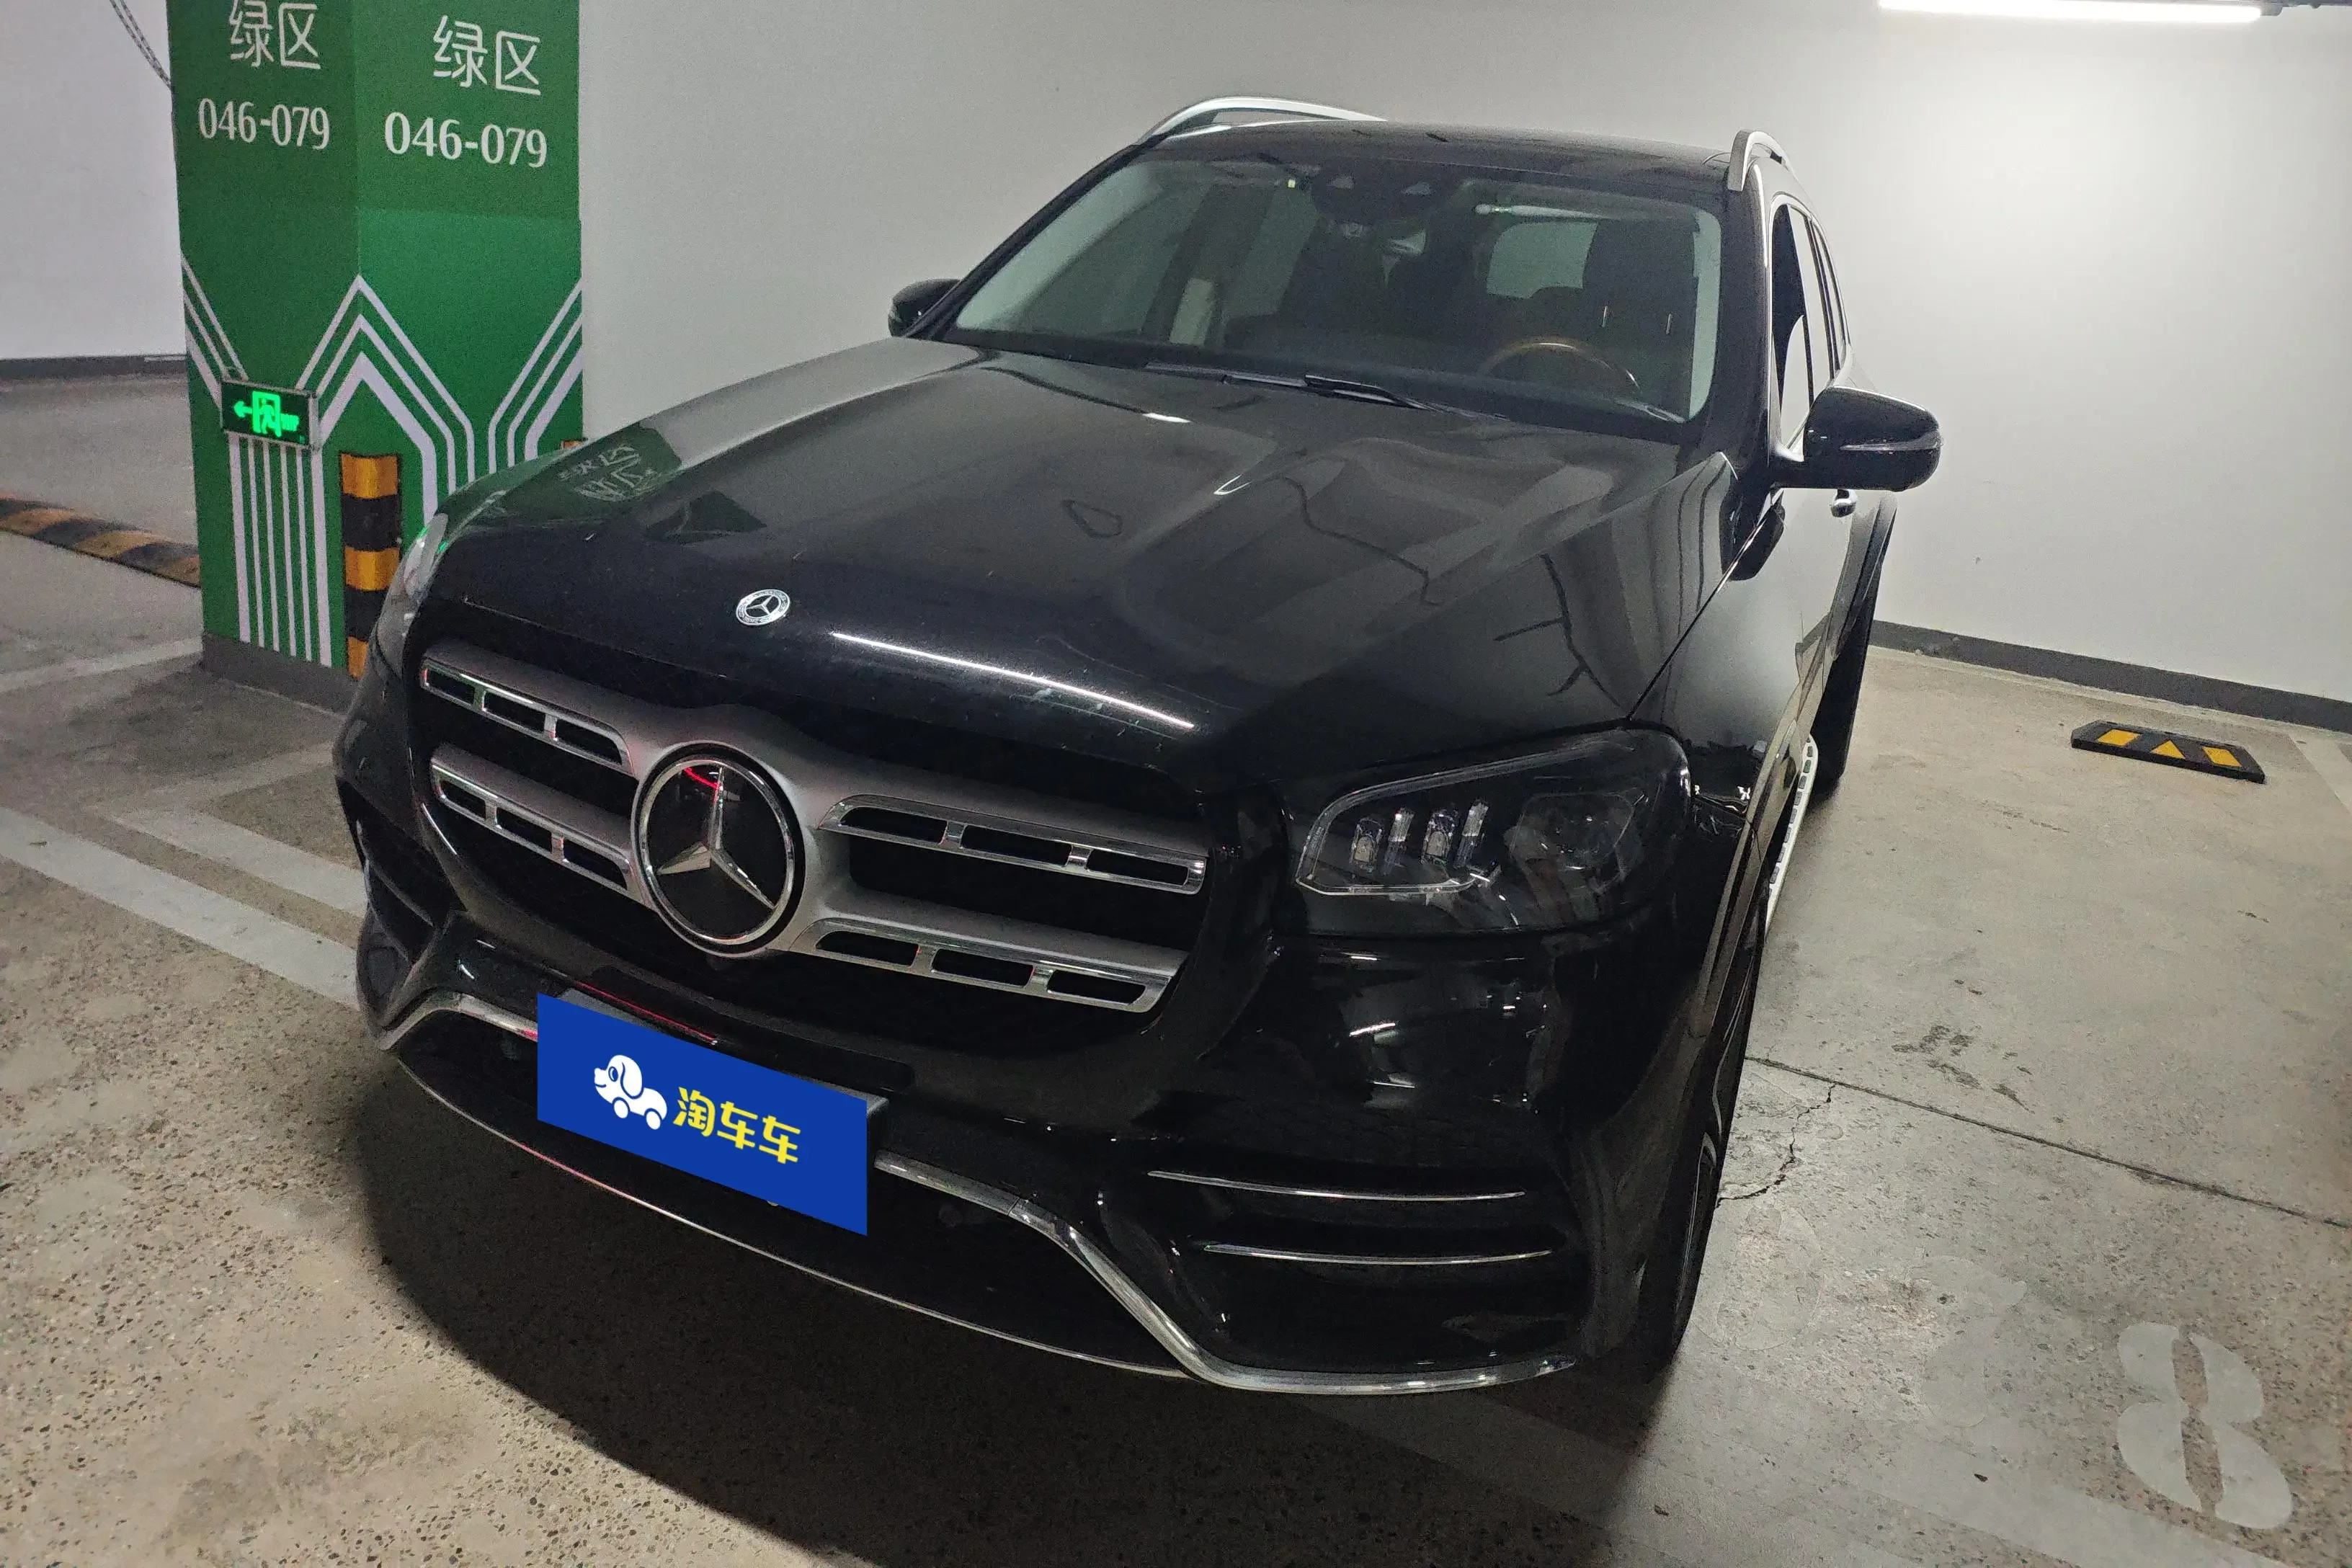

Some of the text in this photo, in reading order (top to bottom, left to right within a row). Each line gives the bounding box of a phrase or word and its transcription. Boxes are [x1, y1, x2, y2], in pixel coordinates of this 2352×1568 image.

[229, 0, 321, 69] 绿区
[433, 15, 541, 95] 绿区
[198, 98, 330, 150] 046-079
[384, 112, 548, 167] 046-079
